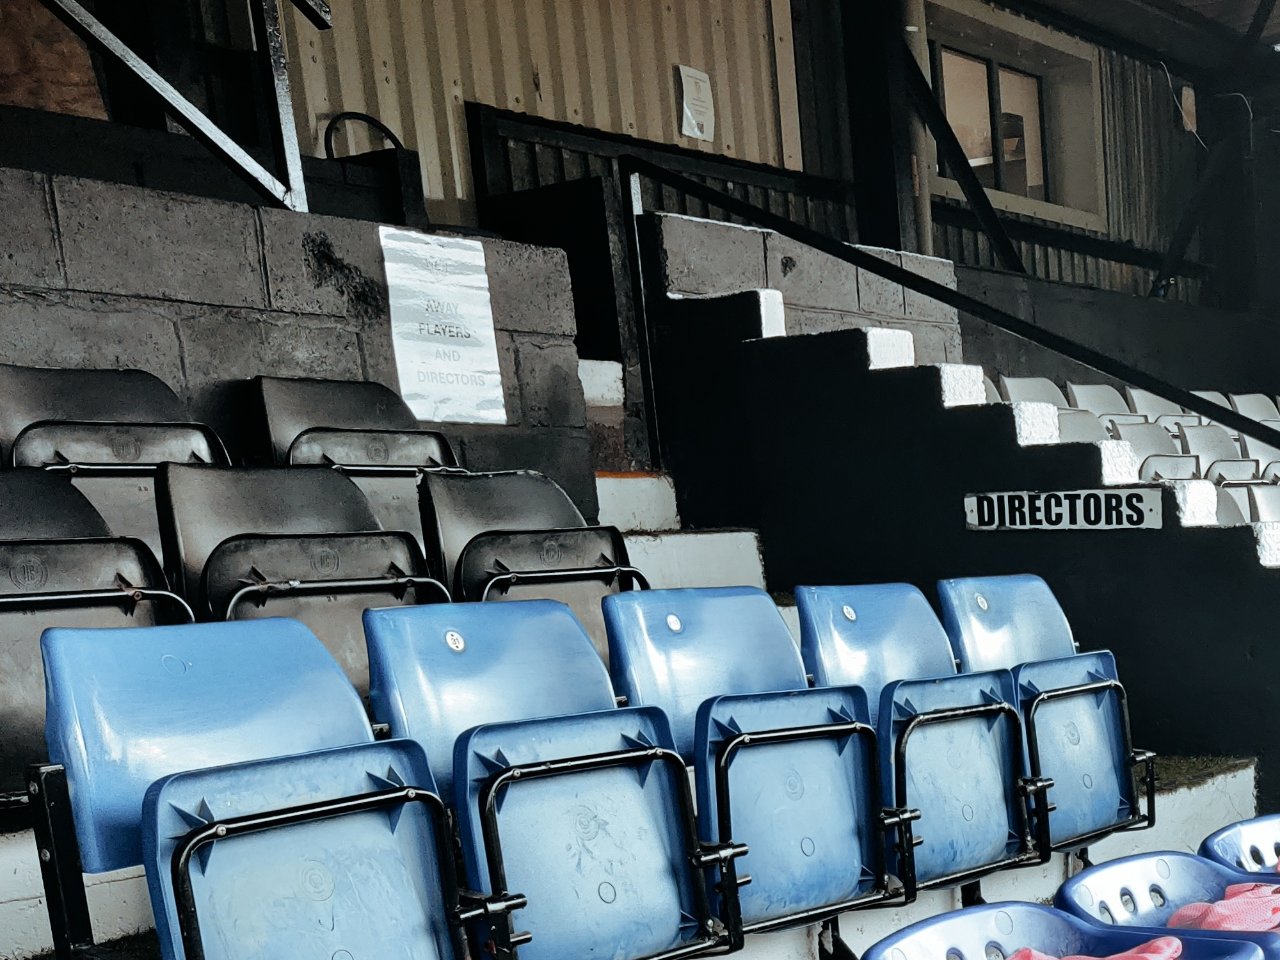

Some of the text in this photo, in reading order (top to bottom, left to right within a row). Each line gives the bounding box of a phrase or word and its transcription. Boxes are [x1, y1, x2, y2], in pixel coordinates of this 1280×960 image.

[425, 299, 460, 315] AWAY
[418, 322, 471, 339] PLAYERS
[435, 349, 461, 362] AND
[417, 370, 486, 387] DIRECTORS
[976, 493, 1145, 527] DIRECTORS
